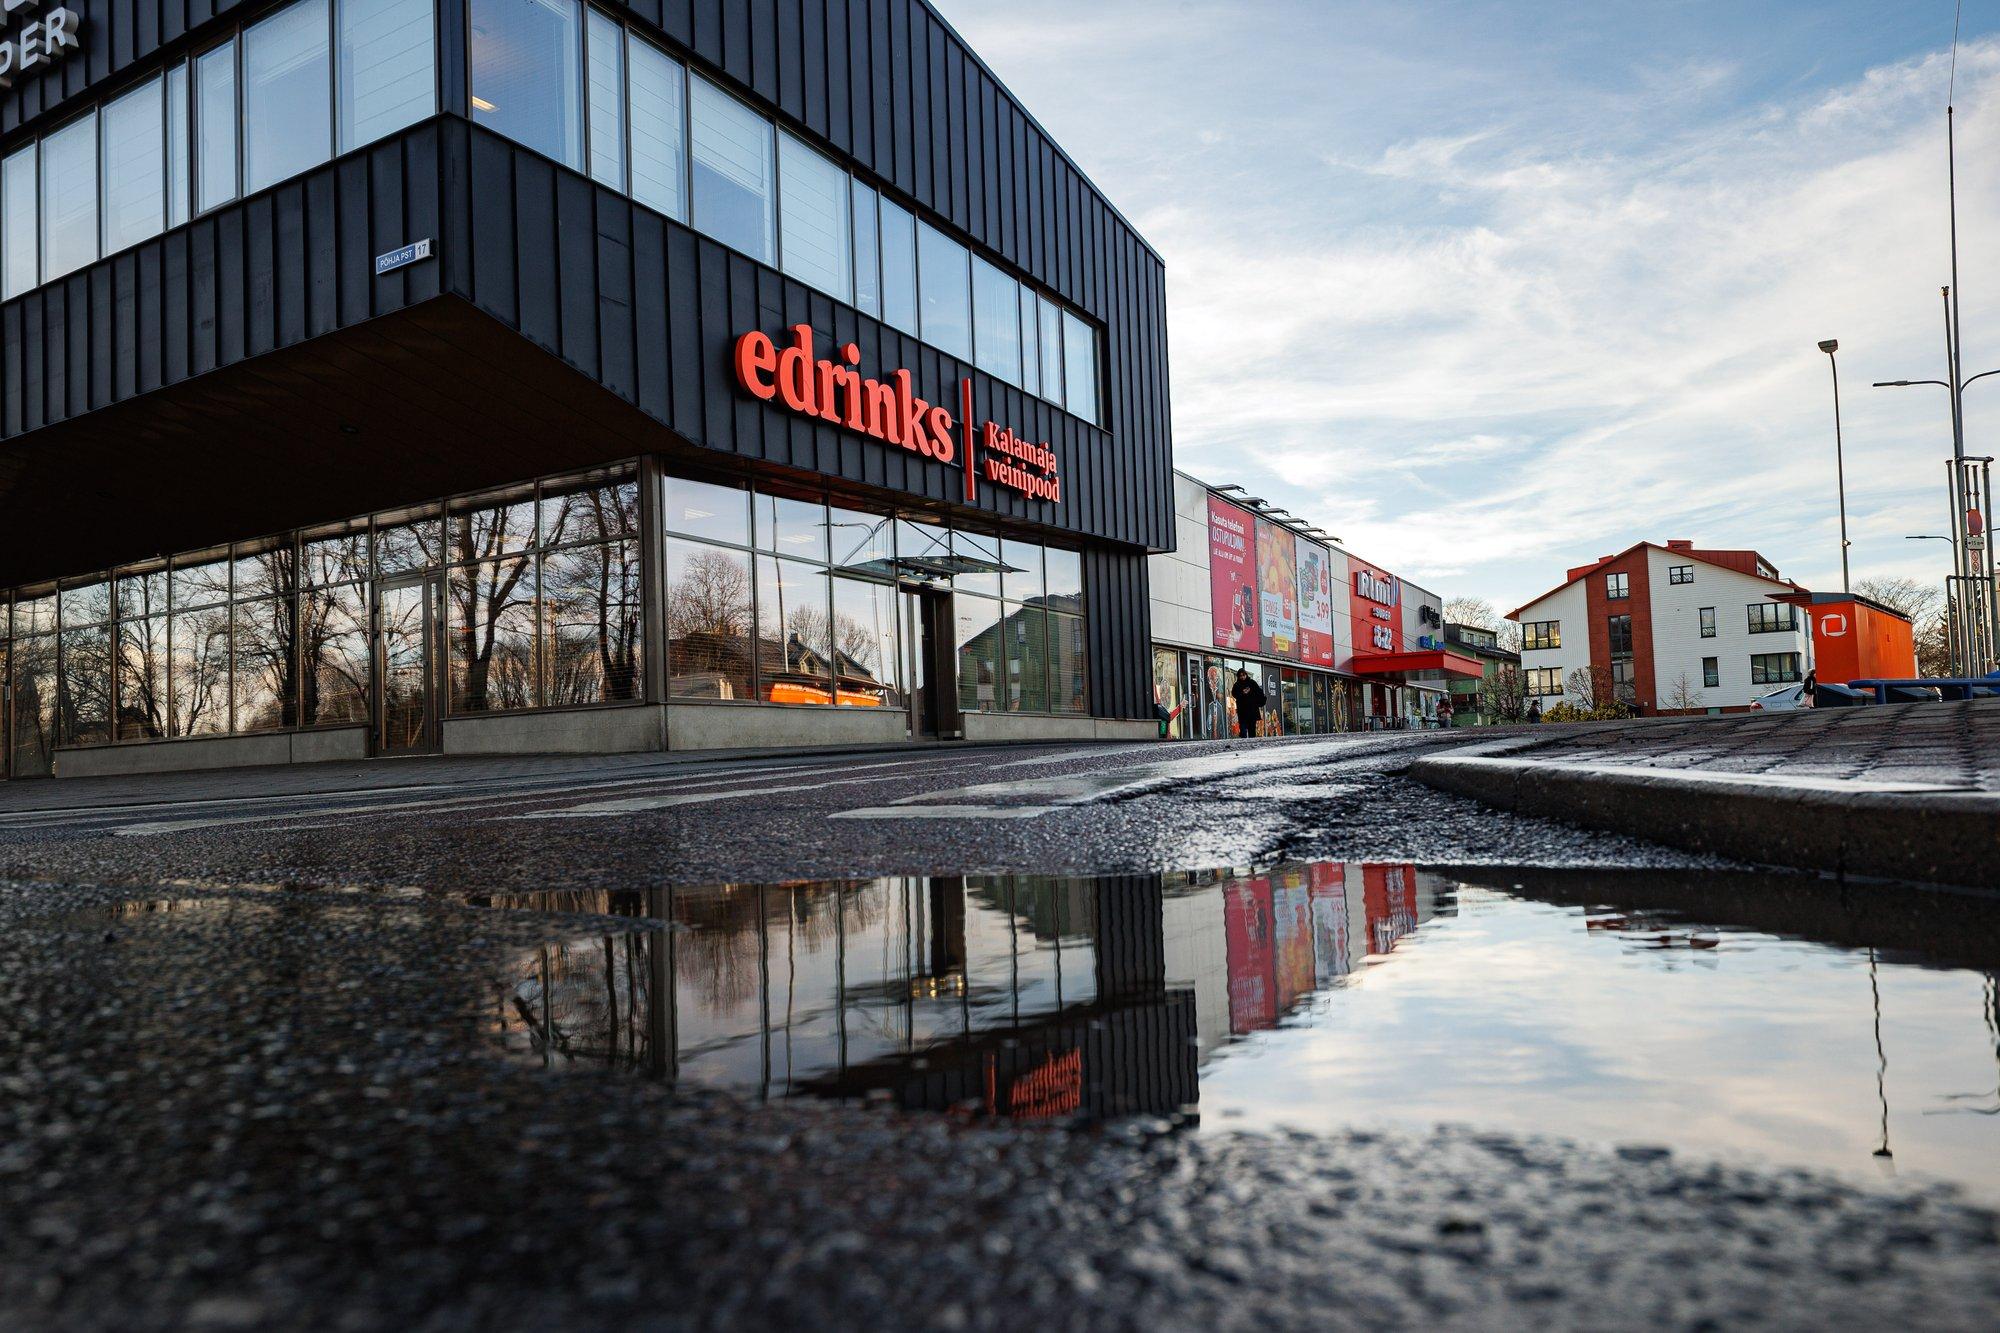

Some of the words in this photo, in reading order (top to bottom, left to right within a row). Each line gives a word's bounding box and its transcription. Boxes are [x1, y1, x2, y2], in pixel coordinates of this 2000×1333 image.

[380, 254, 400, 269] PÕHJA
[401, 249, 413, 261] PST
[417, 243, 427, 256] 17
[736, 324, 954, 463] edrinks
[985, 420, 1058, 476] Kalamaja
[985, 456, 1061, 503] veinipood
